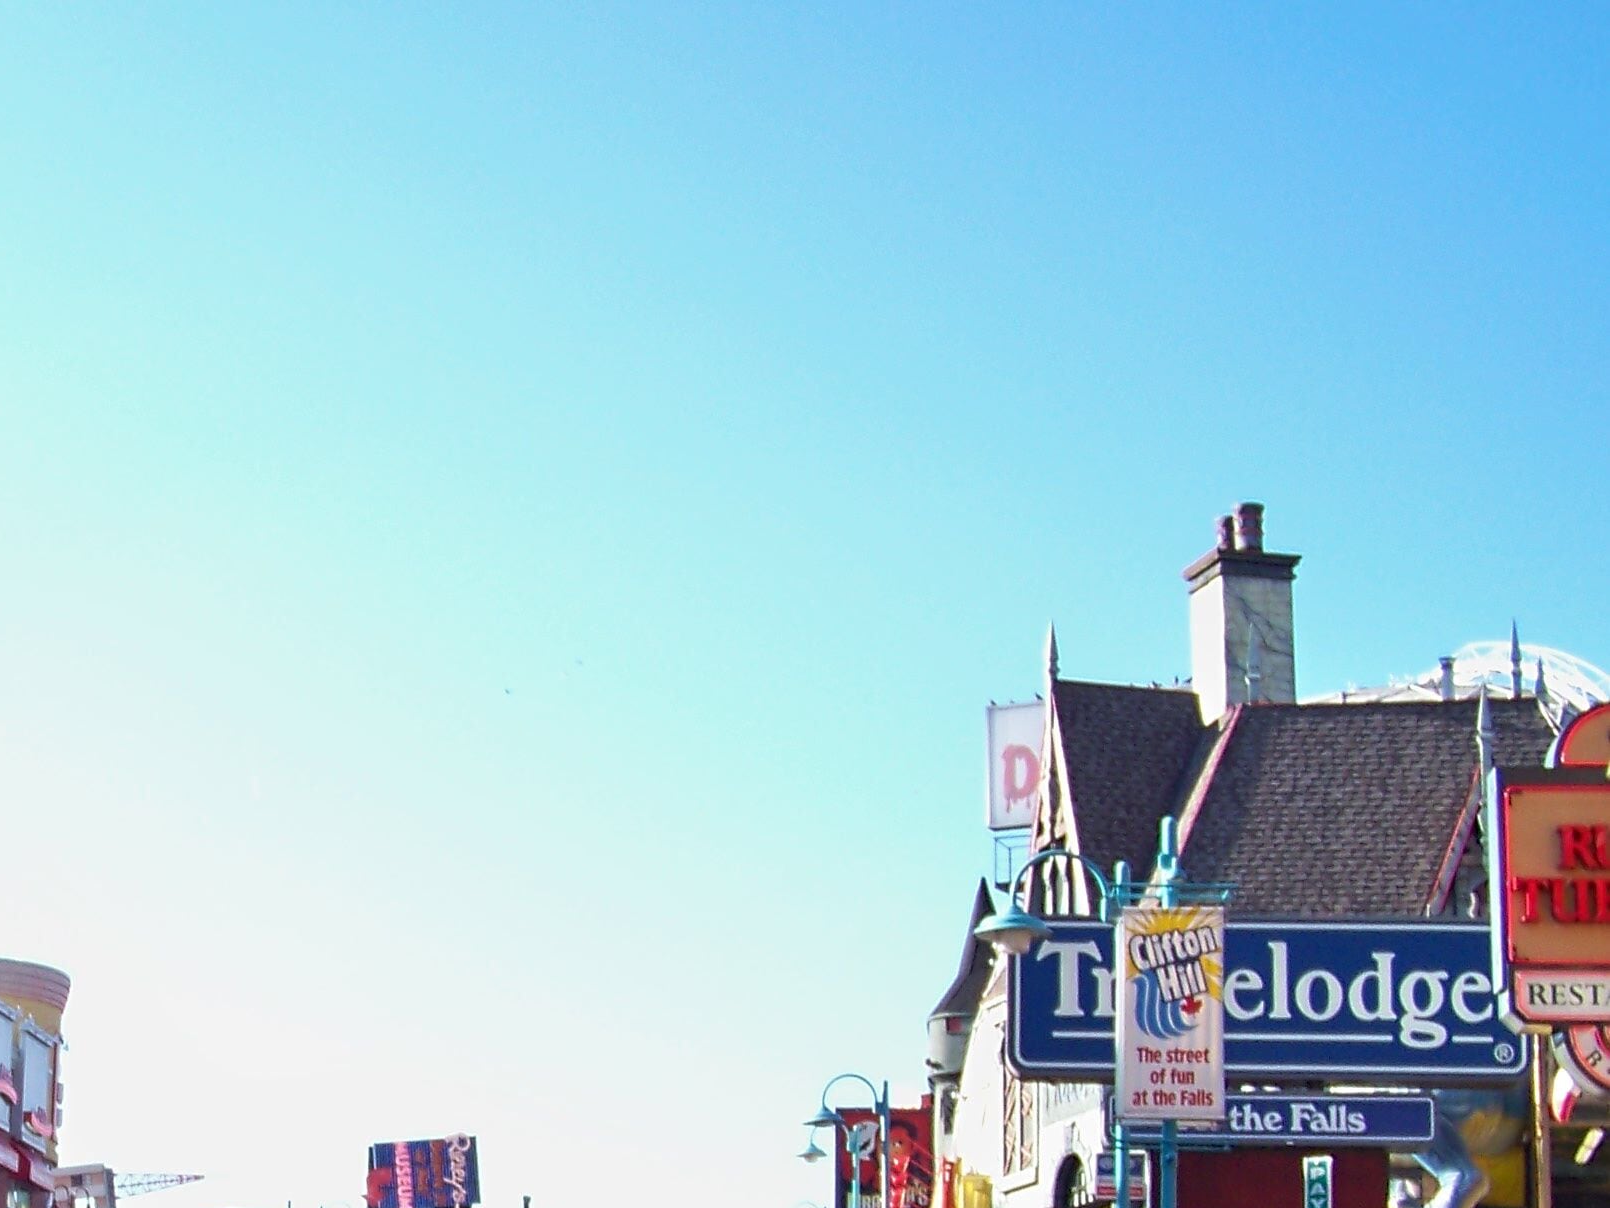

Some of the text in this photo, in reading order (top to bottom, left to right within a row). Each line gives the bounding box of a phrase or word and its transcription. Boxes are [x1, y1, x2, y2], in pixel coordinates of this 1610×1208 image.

[1127, 926, 1218, 970] Clifton
[1156, 958, 1209, 1003] Hill
[1036, 940, 1494, 1049] Trelodge
[1529, 983, 1610, 1007] REST
[1137, 1047, 1210, 1063] The street
[1150, 1068, 1194, 1085] of fun
[1132, 1090, 1213, 1106] at the Falls
[1229, 1103, 1366, 1133] the Falls
